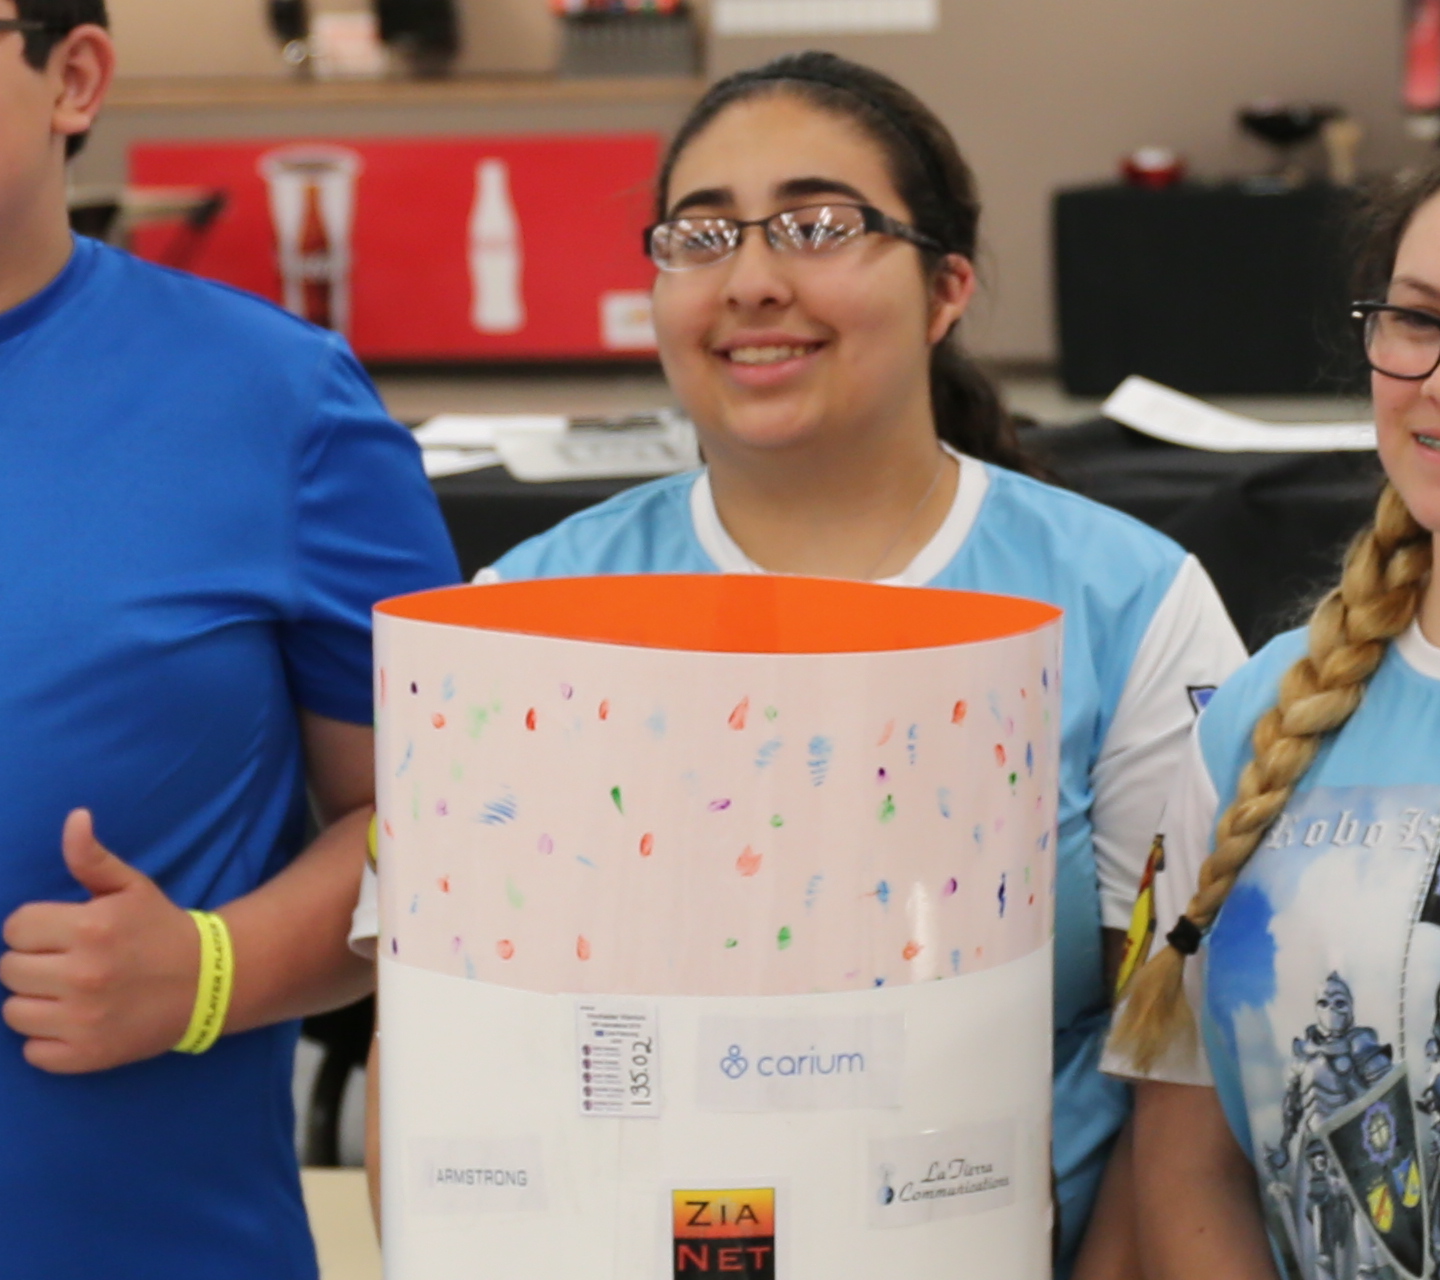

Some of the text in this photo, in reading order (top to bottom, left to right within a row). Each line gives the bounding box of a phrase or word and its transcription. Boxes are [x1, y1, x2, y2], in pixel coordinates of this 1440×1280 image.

[756, 1045, 865, 1077] carium
[436, 1167, 528, 1187] ARMSTRONG
[898, 1175, 1010, 1202] Communications
